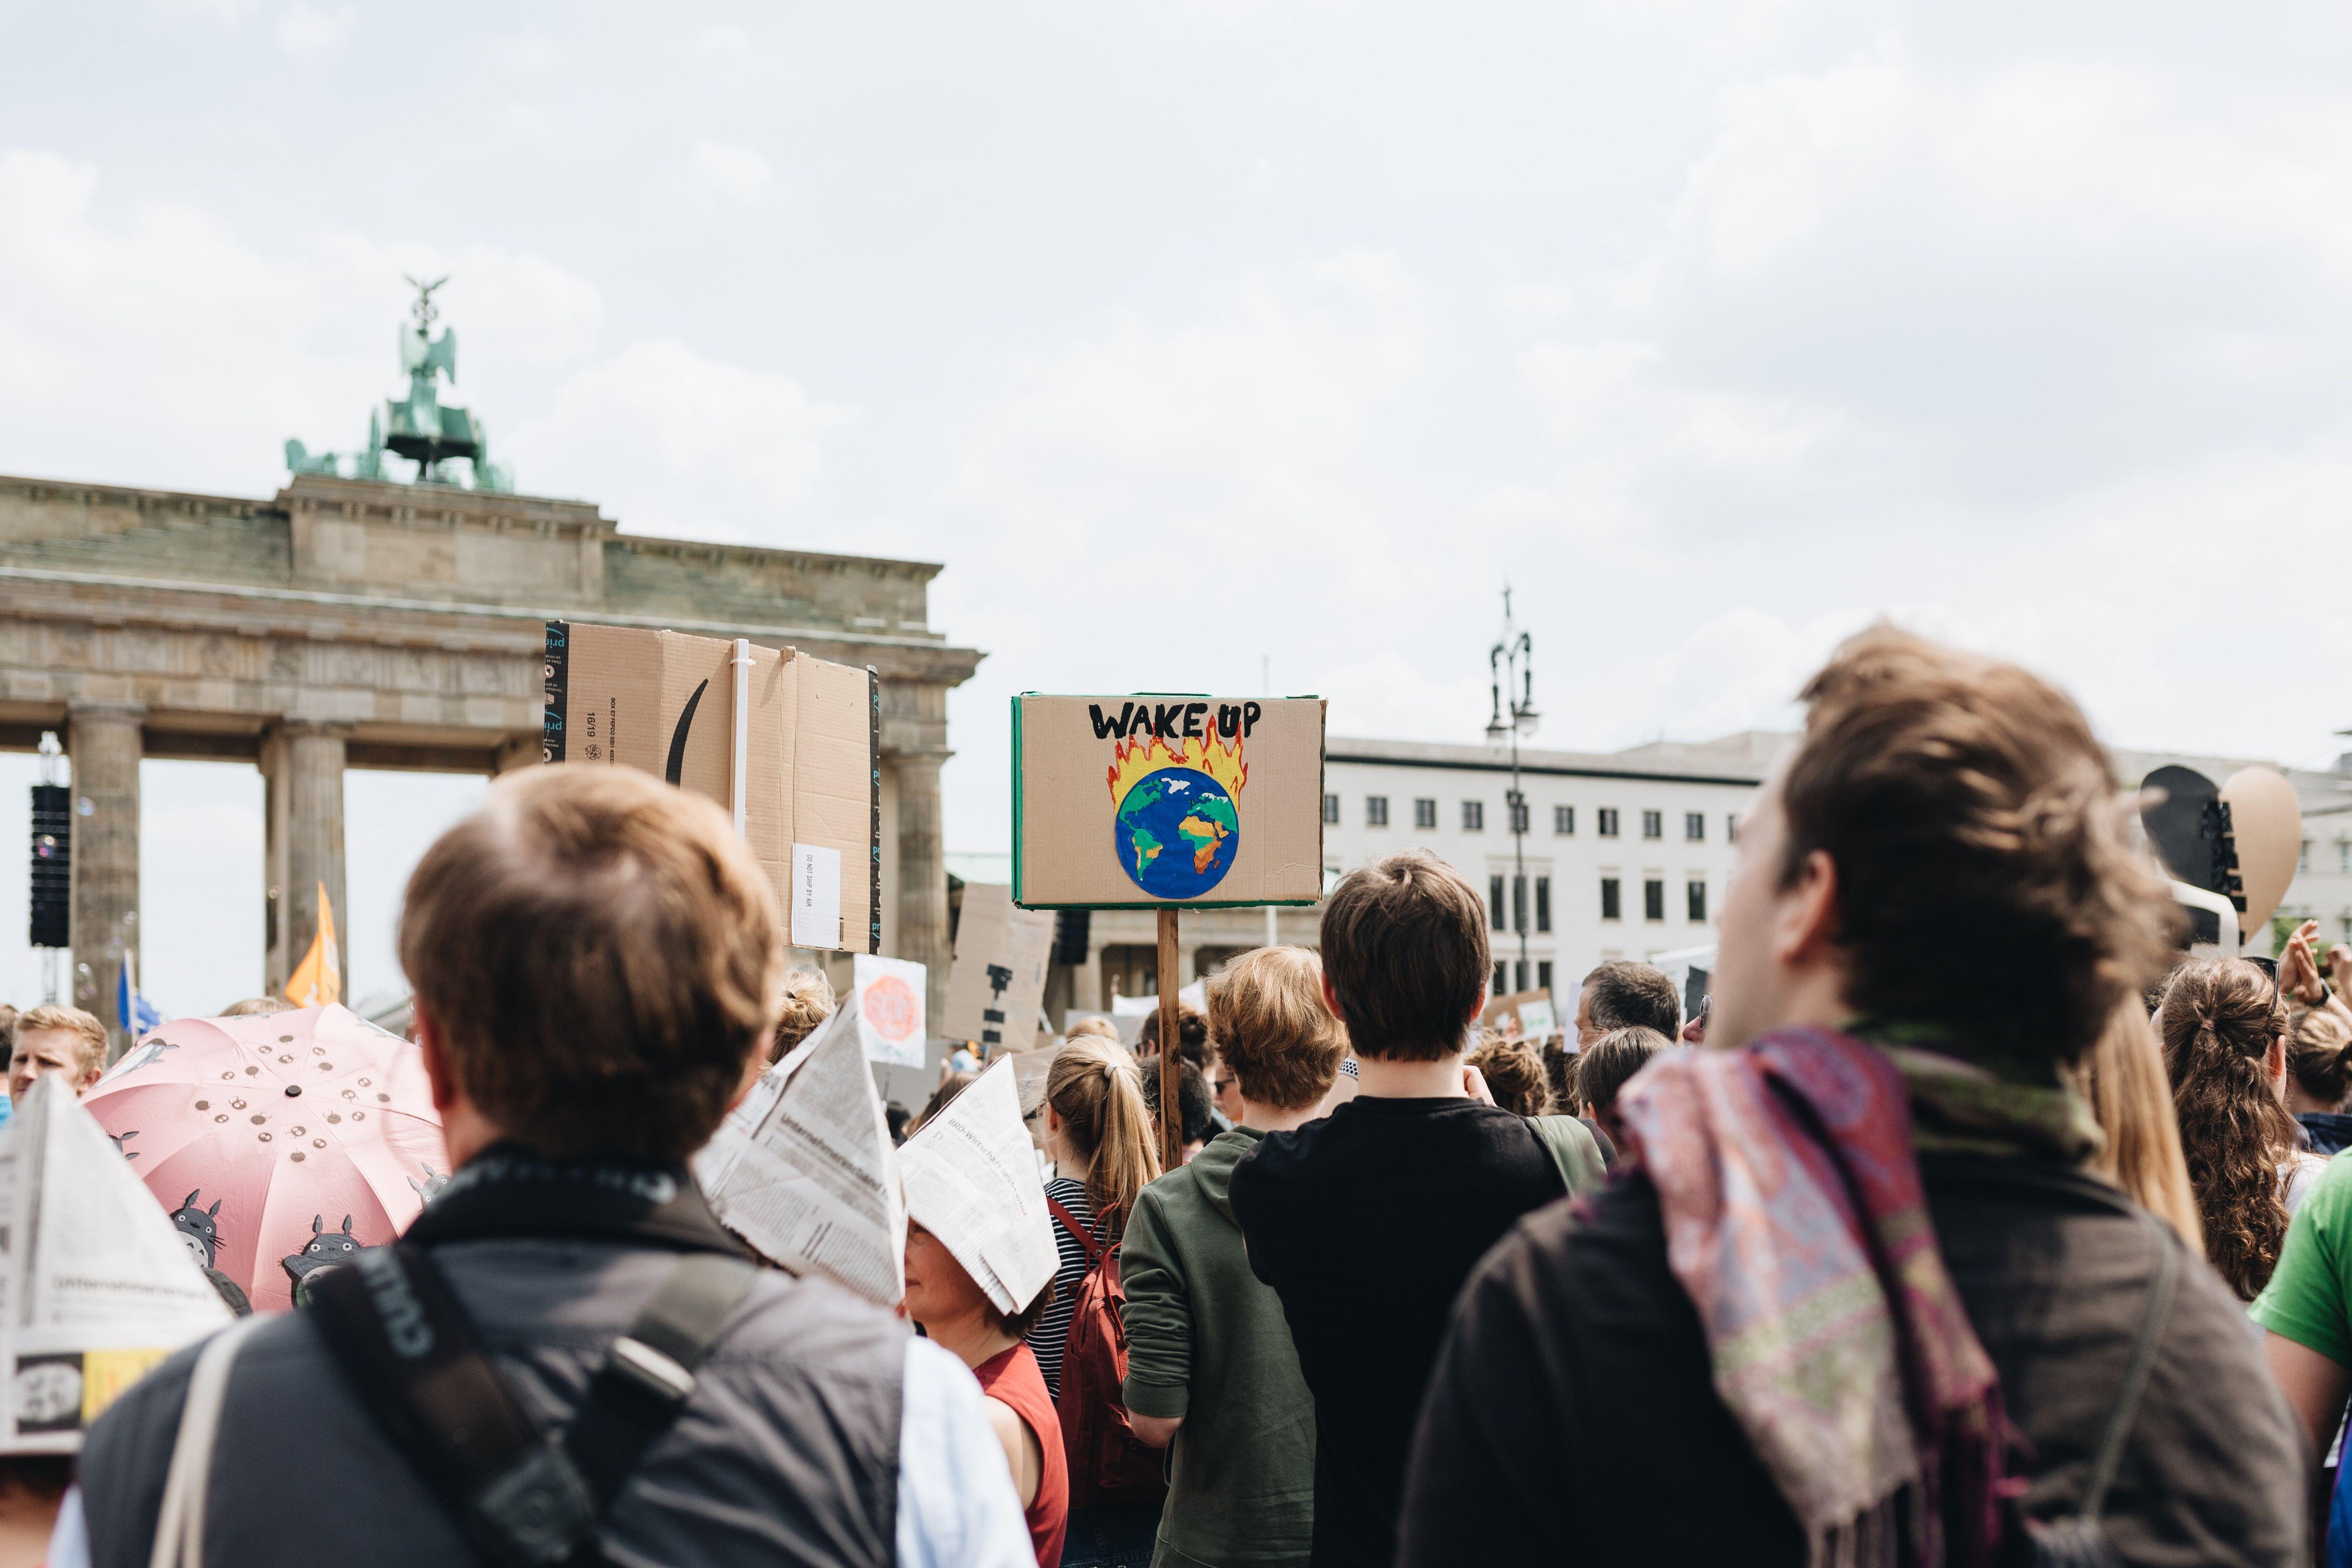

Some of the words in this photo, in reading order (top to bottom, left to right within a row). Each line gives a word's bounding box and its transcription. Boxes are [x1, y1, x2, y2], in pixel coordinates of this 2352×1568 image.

[587, 712, 596, 737] 16/19
[1089, 702, 1208, 739] WAKE
[1218, 701, 1261, 738] UP
[948, 1119, 1002, 1170] BRD-Wirtschaft
